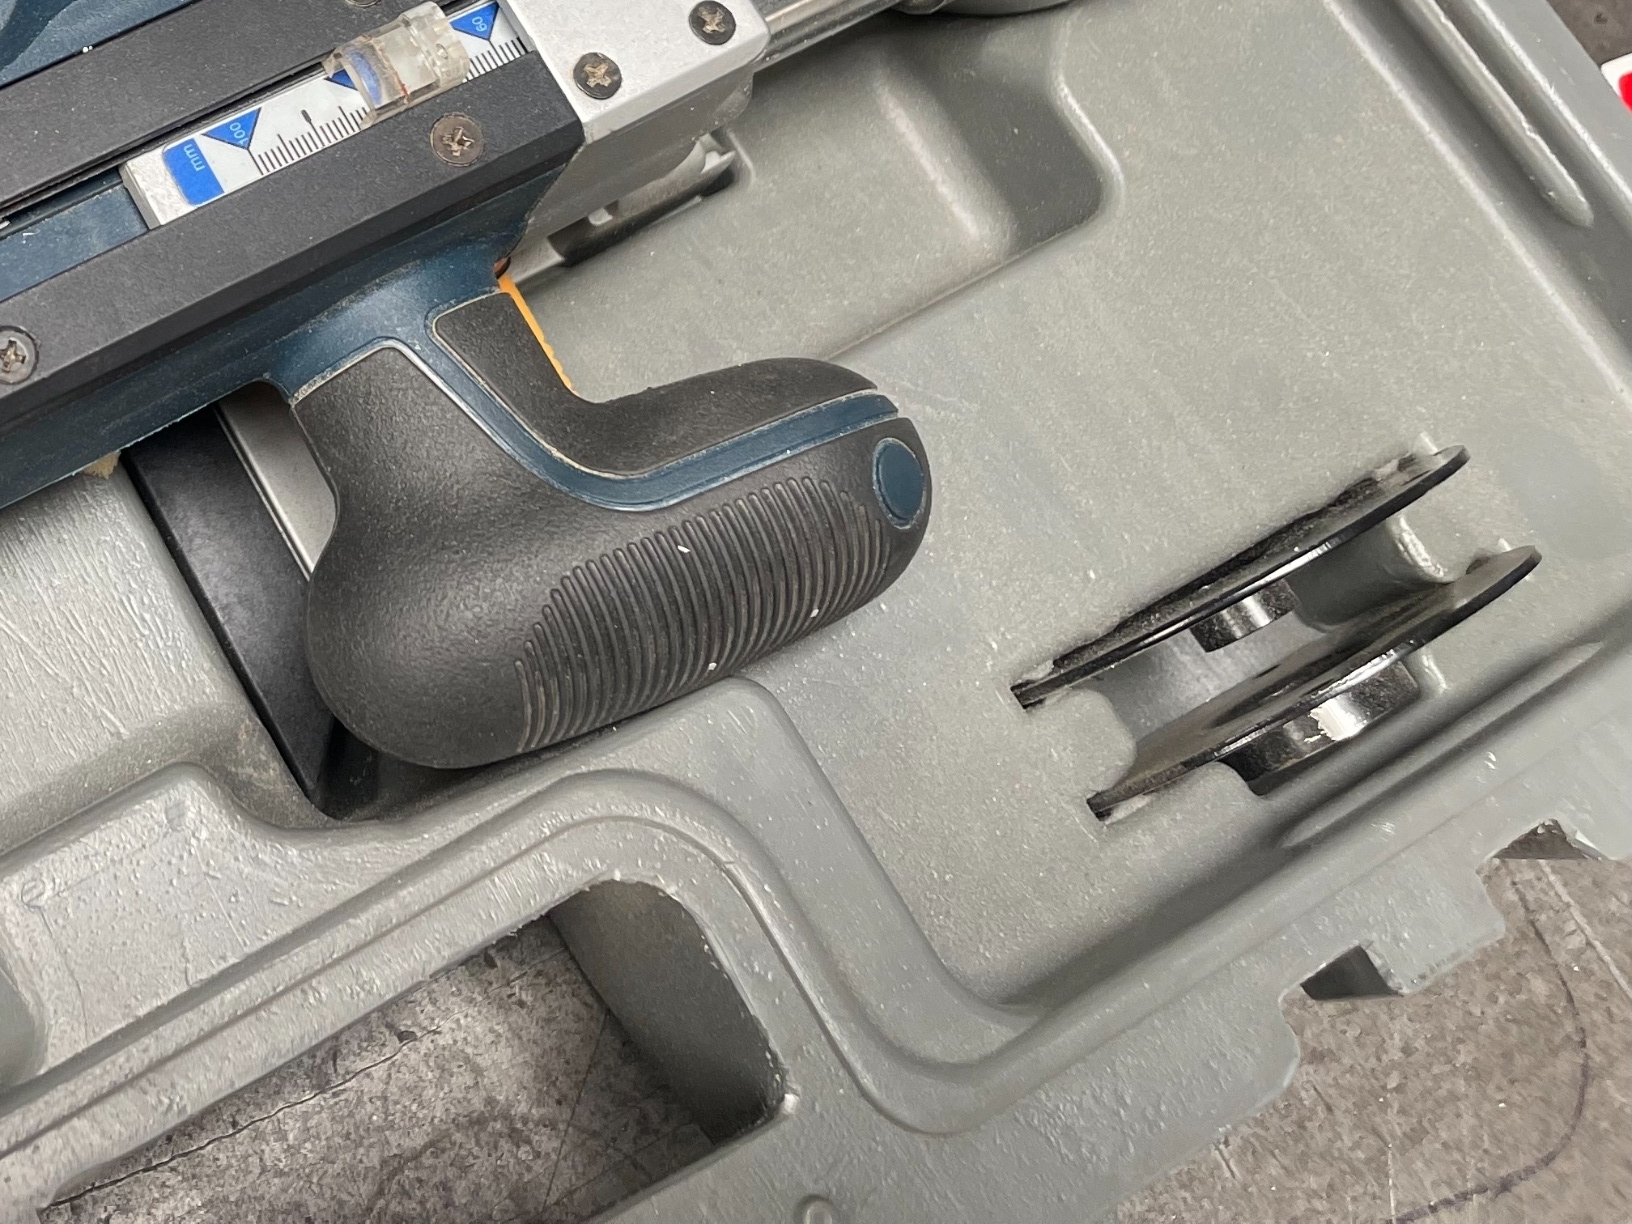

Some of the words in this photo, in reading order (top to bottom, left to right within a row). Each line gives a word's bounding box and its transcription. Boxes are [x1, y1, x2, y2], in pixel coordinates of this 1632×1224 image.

[471, 15, 488, 32] 60
[229, 121, 249, 147] 100
[183, 143, 206, 173] mm
